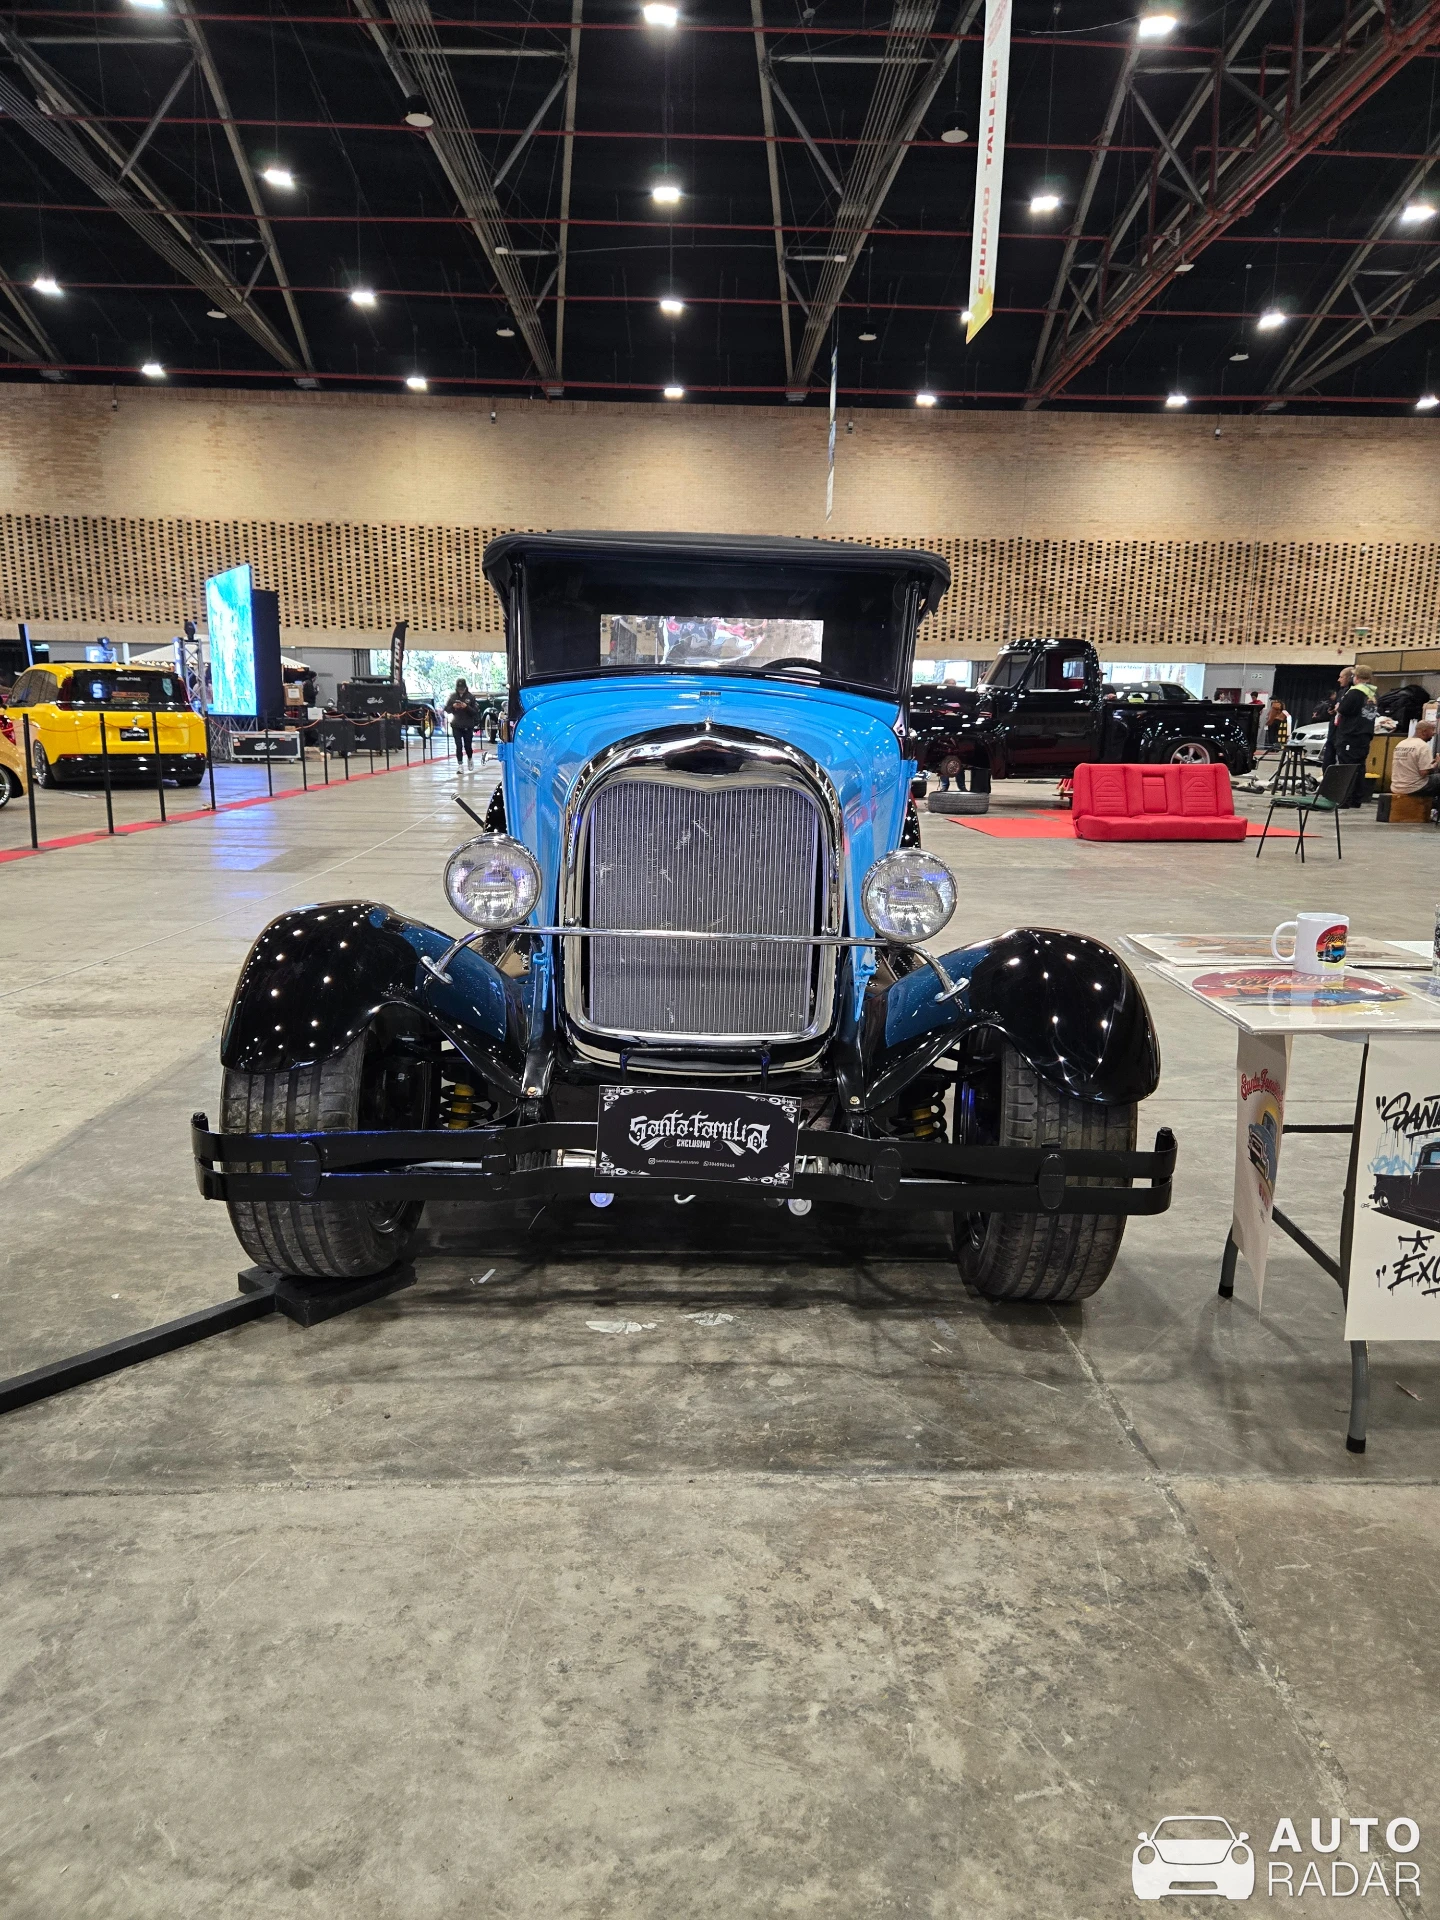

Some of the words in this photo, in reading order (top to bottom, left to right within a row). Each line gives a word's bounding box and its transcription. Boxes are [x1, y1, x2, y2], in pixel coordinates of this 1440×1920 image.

[978, 187, 990, 295] CIUDAD
[985, 59, 998, 170] TALLER
[676, 1138, 711, 1149] EXCLUSIVO
